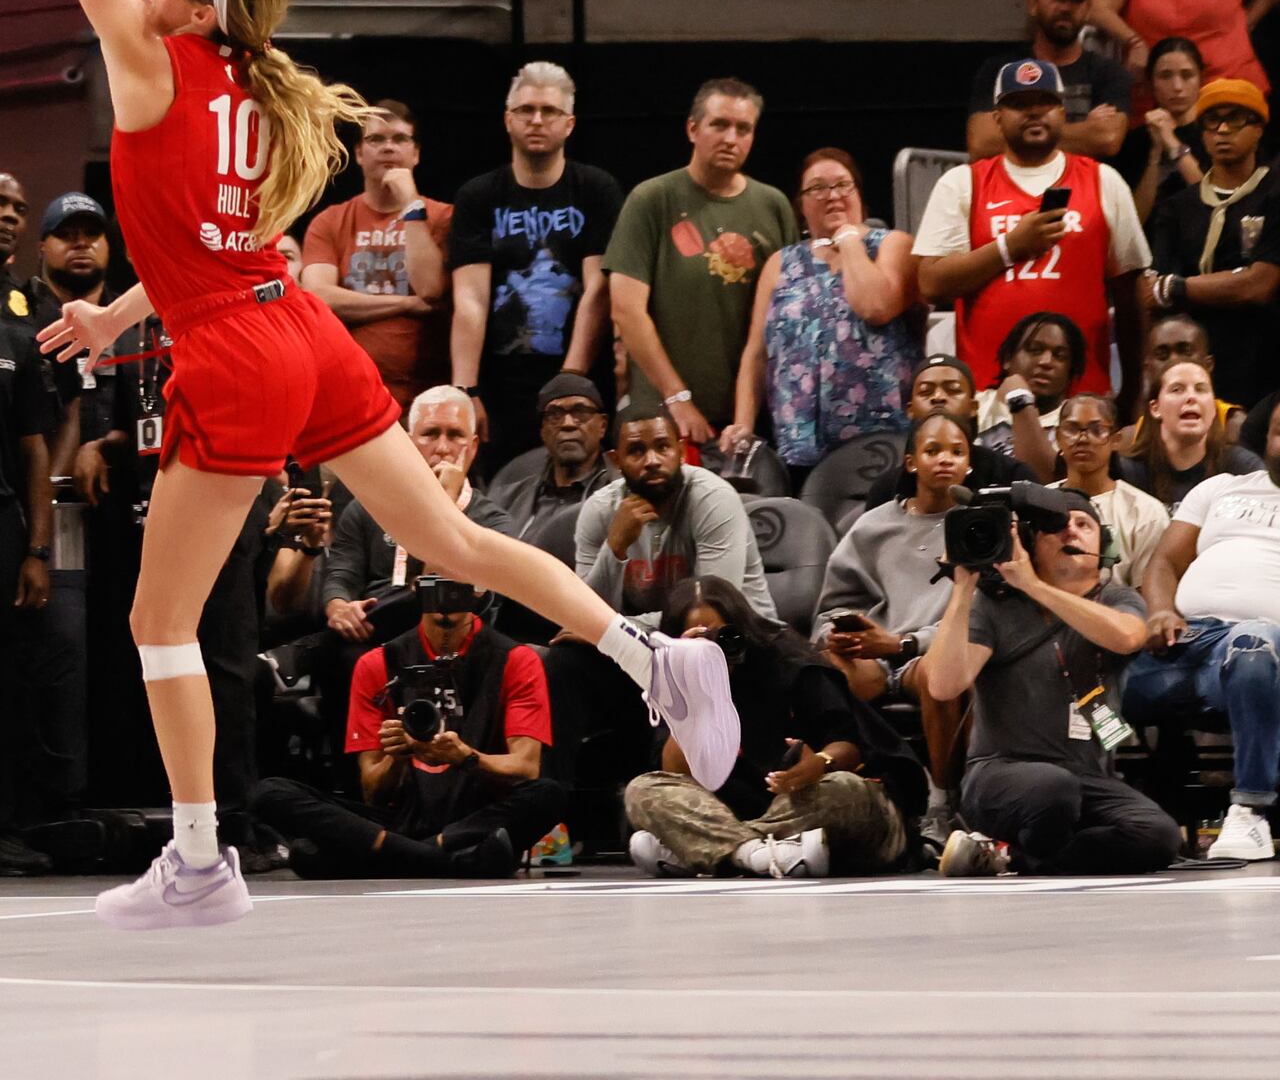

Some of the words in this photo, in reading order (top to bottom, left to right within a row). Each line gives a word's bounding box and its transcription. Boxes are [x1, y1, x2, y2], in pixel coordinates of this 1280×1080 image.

[208, 94, 271, 181] 10
[217, 183, 251, 218] HULL
[224, 230, 263, 253] AT&
[492, 205, 586, 249] VENDED
[991, 210, 1084, 239] FER
